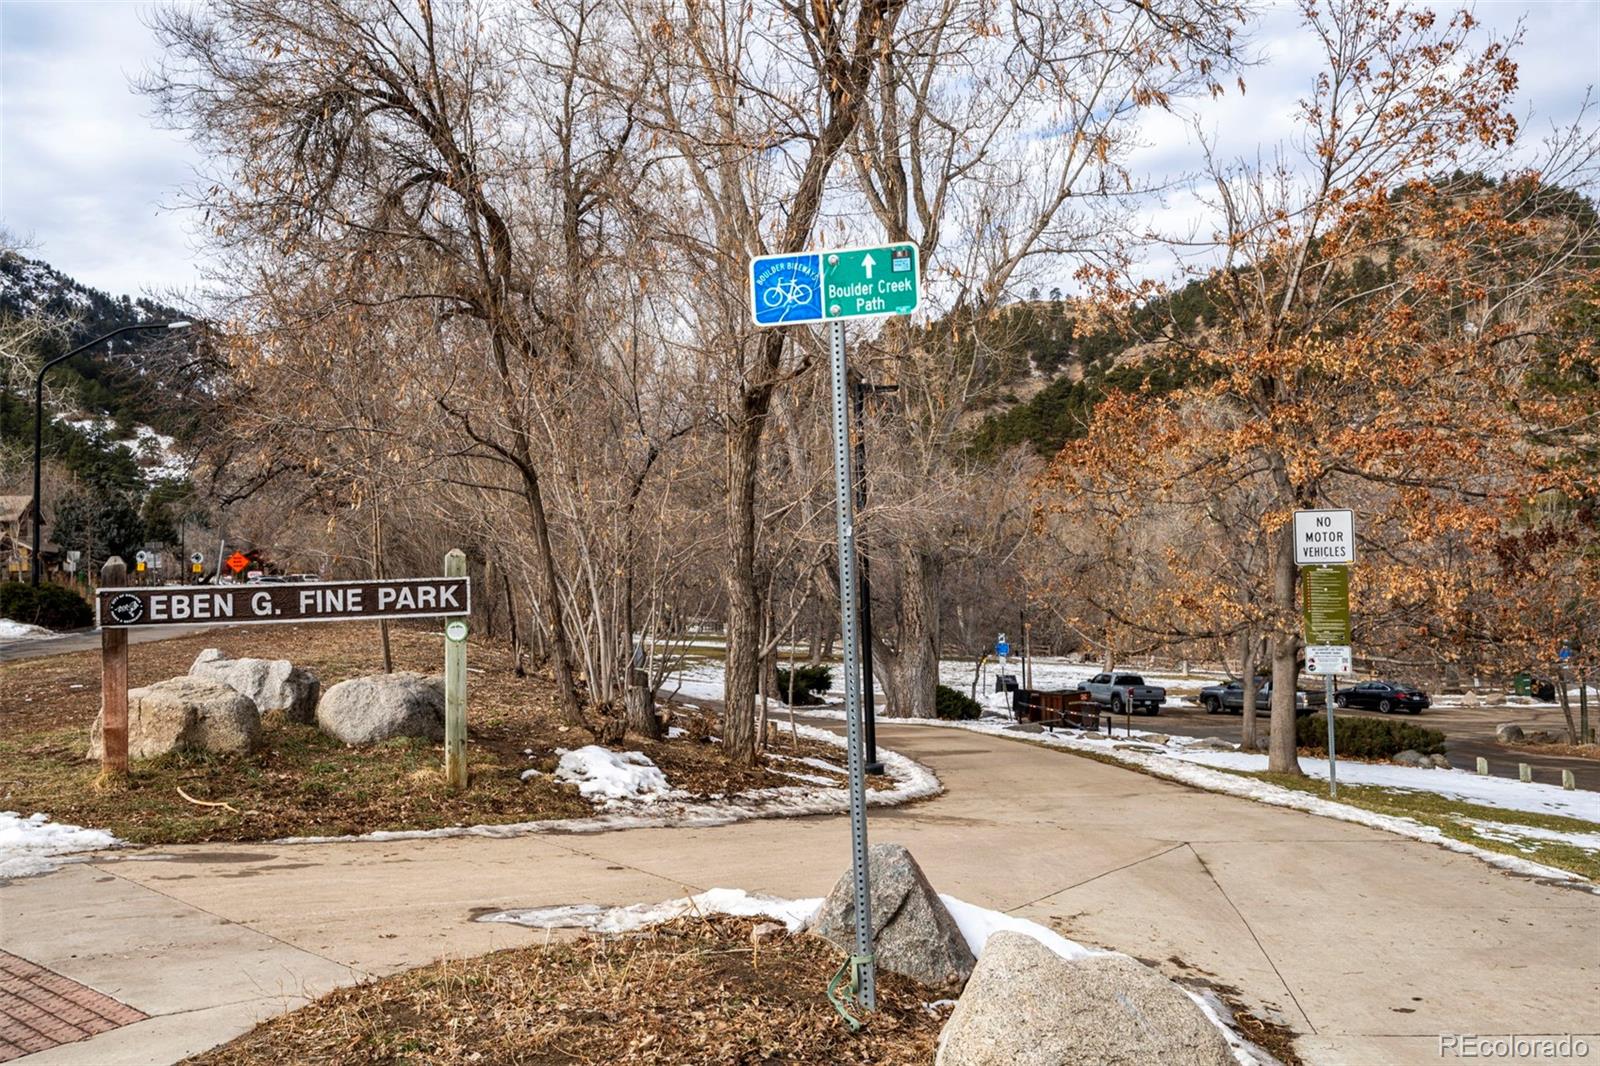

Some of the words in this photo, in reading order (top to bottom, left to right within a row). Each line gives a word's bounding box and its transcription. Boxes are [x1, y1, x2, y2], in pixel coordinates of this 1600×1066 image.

[756, 262, 785, 286] BOULDER
[786, 262, 819, 282] BIKEWAYS
[828, 283, 873, 298] Boulder
[878, 279, 912, 293] Creek
[856, 297, 885, 312] Path
[1316, 517, 1331, 527] NO
[1305, 532, 1344, 542] MOTOR
[1303, 547, 1346, 557] VEHICLES
[149, 592, 233, 620] EBEN
[251, 591, 282, 616] G.
[299, 588, 363, 613] FINE
[378, 585, 460, 610] PARK
